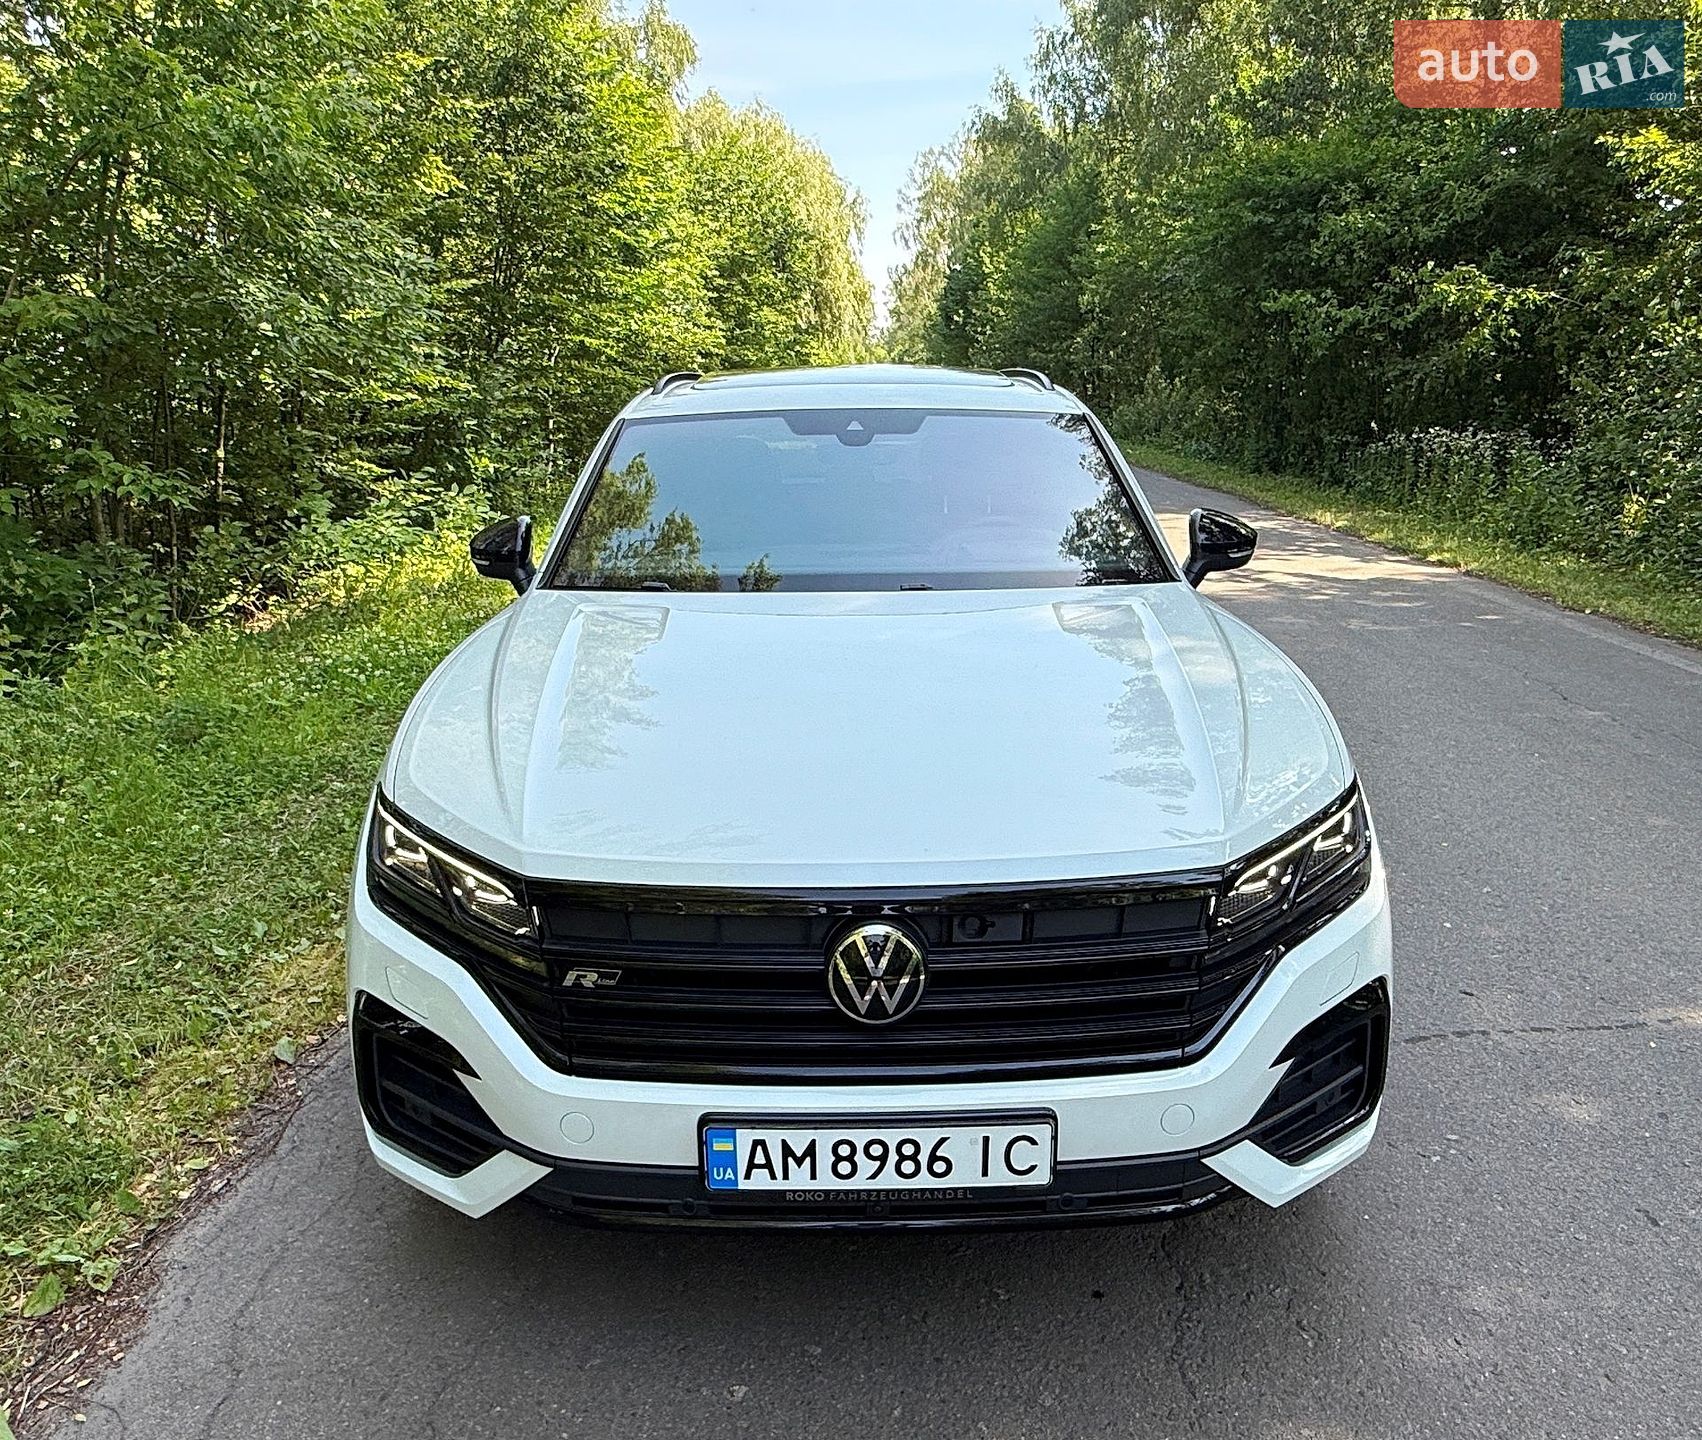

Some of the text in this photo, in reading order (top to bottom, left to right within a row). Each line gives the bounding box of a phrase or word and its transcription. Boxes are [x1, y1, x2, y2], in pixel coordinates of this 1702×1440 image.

[562, 970, 598, 988] R
[832, 925, 925, 1020] VW
[744, 1134, 1040, 1181] AM 8986 IC
[713, 1167, 735, 1181] UA
[786, 1189, 973, 1202] ROKO FAHRZEUGHANDEL
